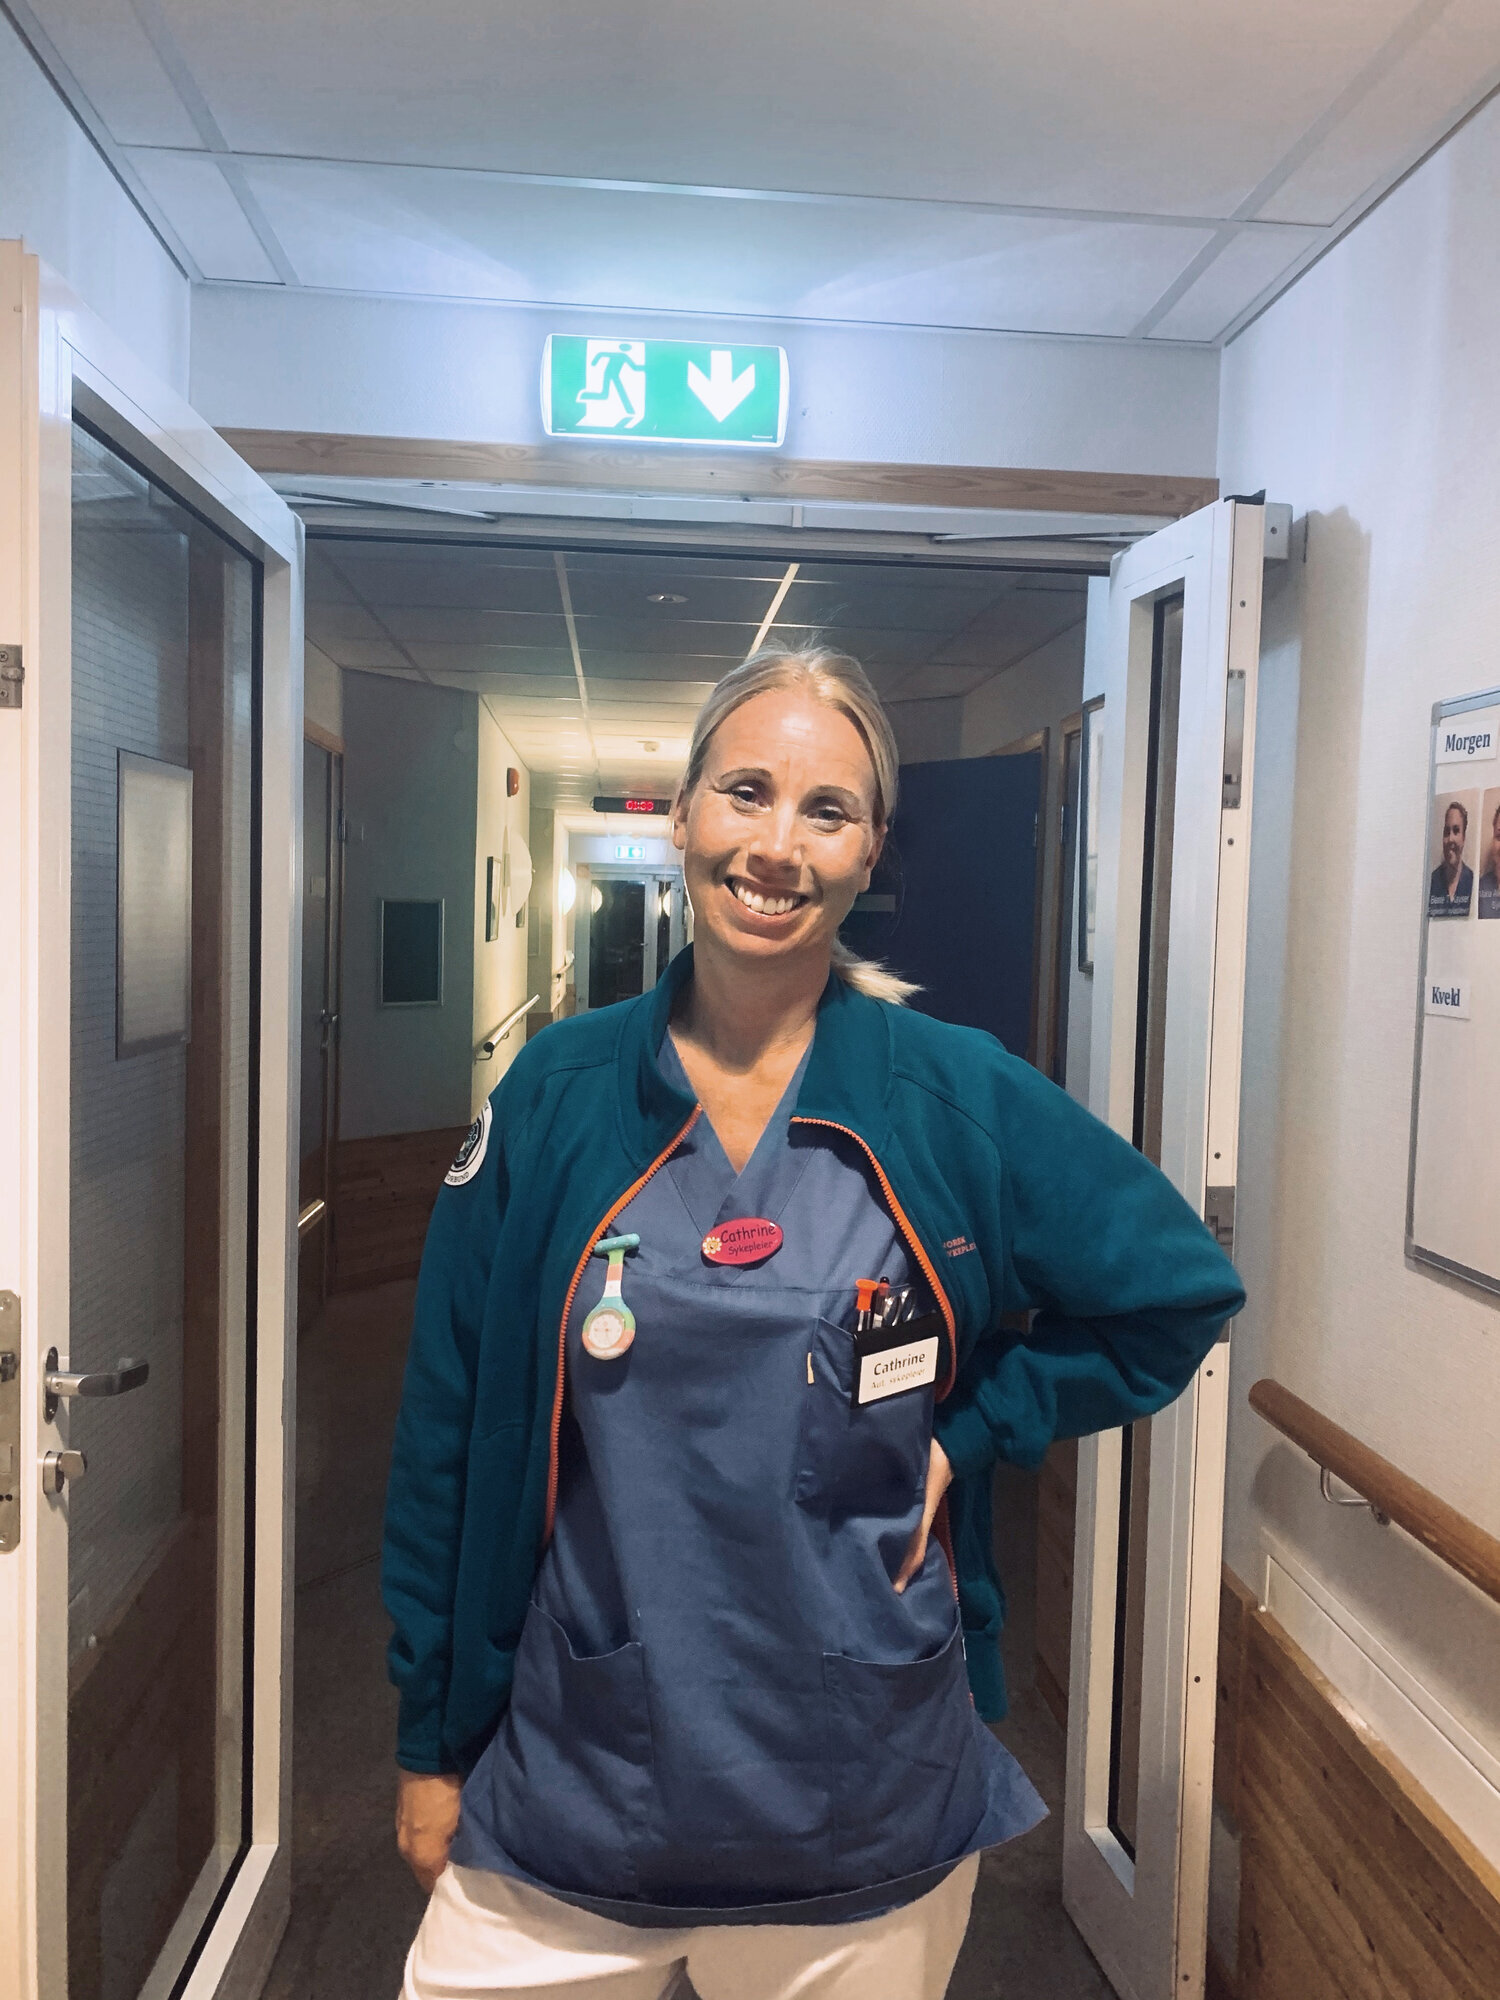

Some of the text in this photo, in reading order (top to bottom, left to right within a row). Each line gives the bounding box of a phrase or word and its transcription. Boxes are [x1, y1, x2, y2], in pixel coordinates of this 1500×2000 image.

[1445, 733, 1491, 755] Morgen
[1432, 986, 1461, 1007] Kveld
[720, 1225, 776, 1243] Cathrine
[873, 1352, 926, 1376] Cathrine
